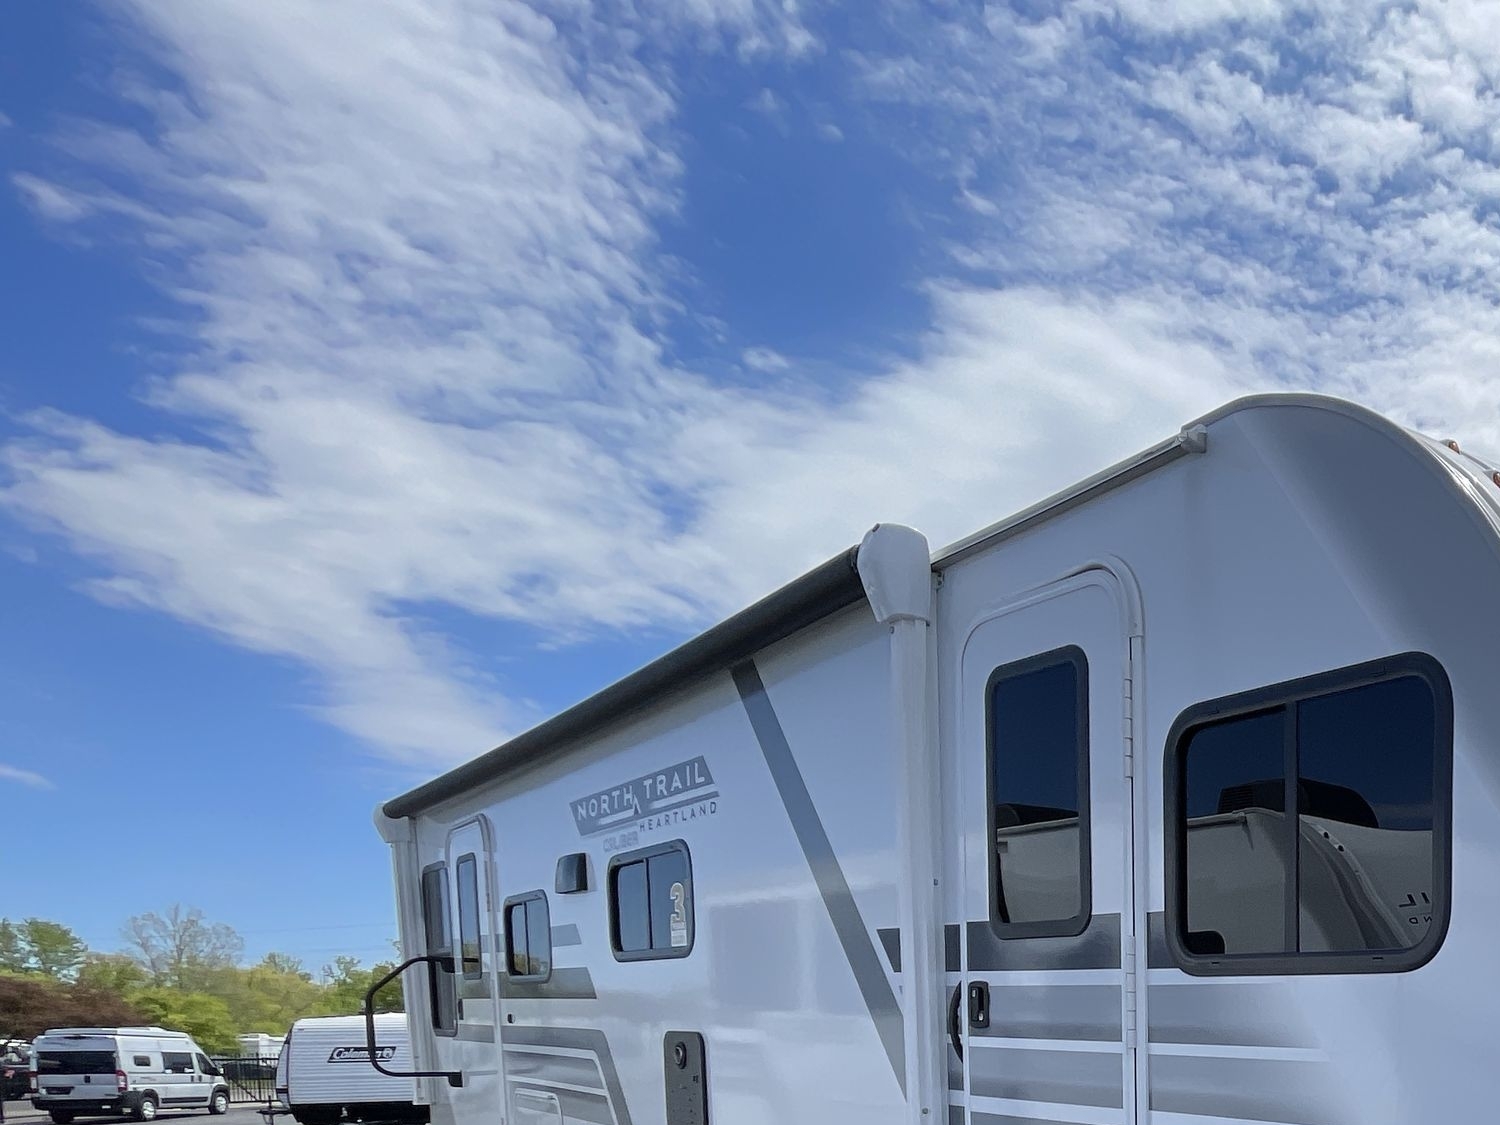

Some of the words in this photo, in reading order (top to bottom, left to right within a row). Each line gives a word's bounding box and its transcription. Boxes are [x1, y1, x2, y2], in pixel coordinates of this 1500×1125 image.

[577, 785, 635, 821] NORTH
[643, 762, 705, 798] TRAIL
[639, 801, 717, 832] HEARTLAND
